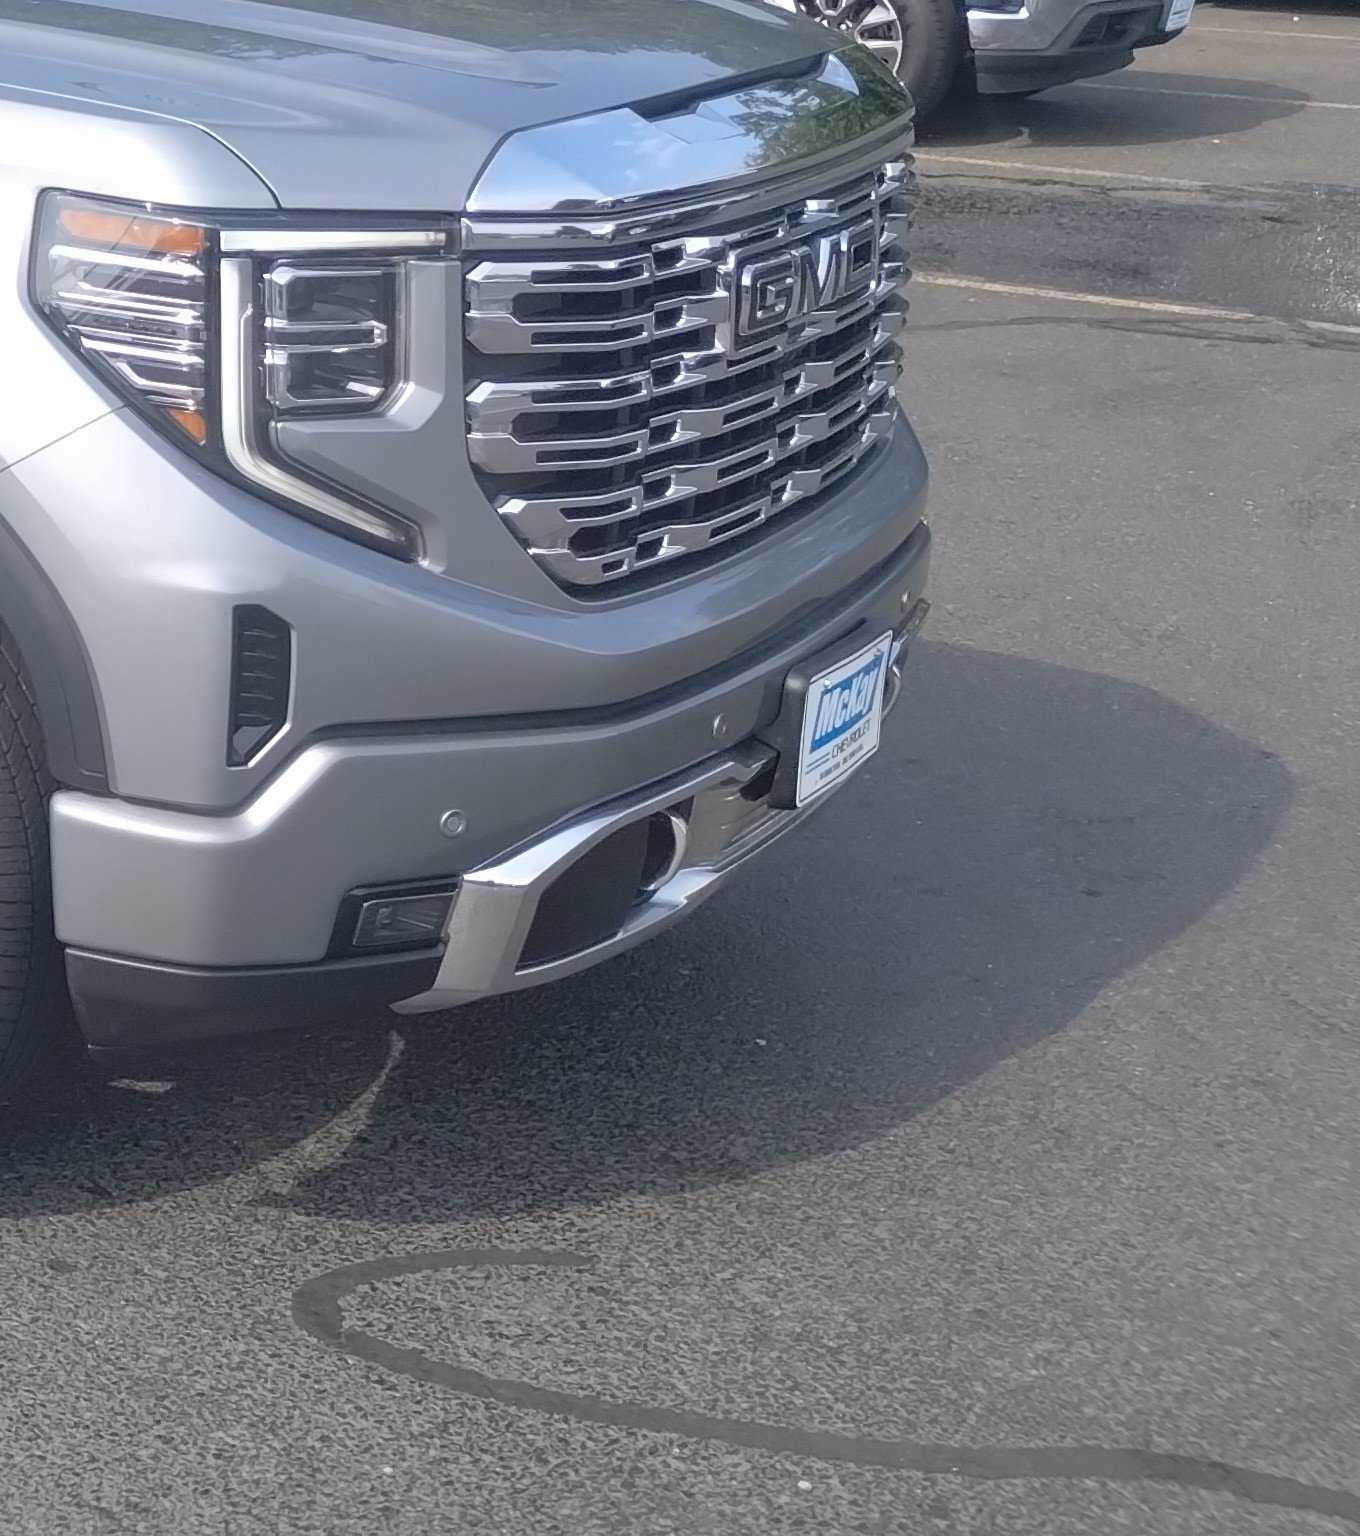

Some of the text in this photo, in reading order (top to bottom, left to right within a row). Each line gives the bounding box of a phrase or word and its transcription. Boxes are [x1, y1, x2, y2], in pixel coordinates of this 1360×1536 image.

[739, 218, 875, 337] GMC
[814, 665, 880, 742] McKay
[831, 718, 872, 759] CHEVROLET
